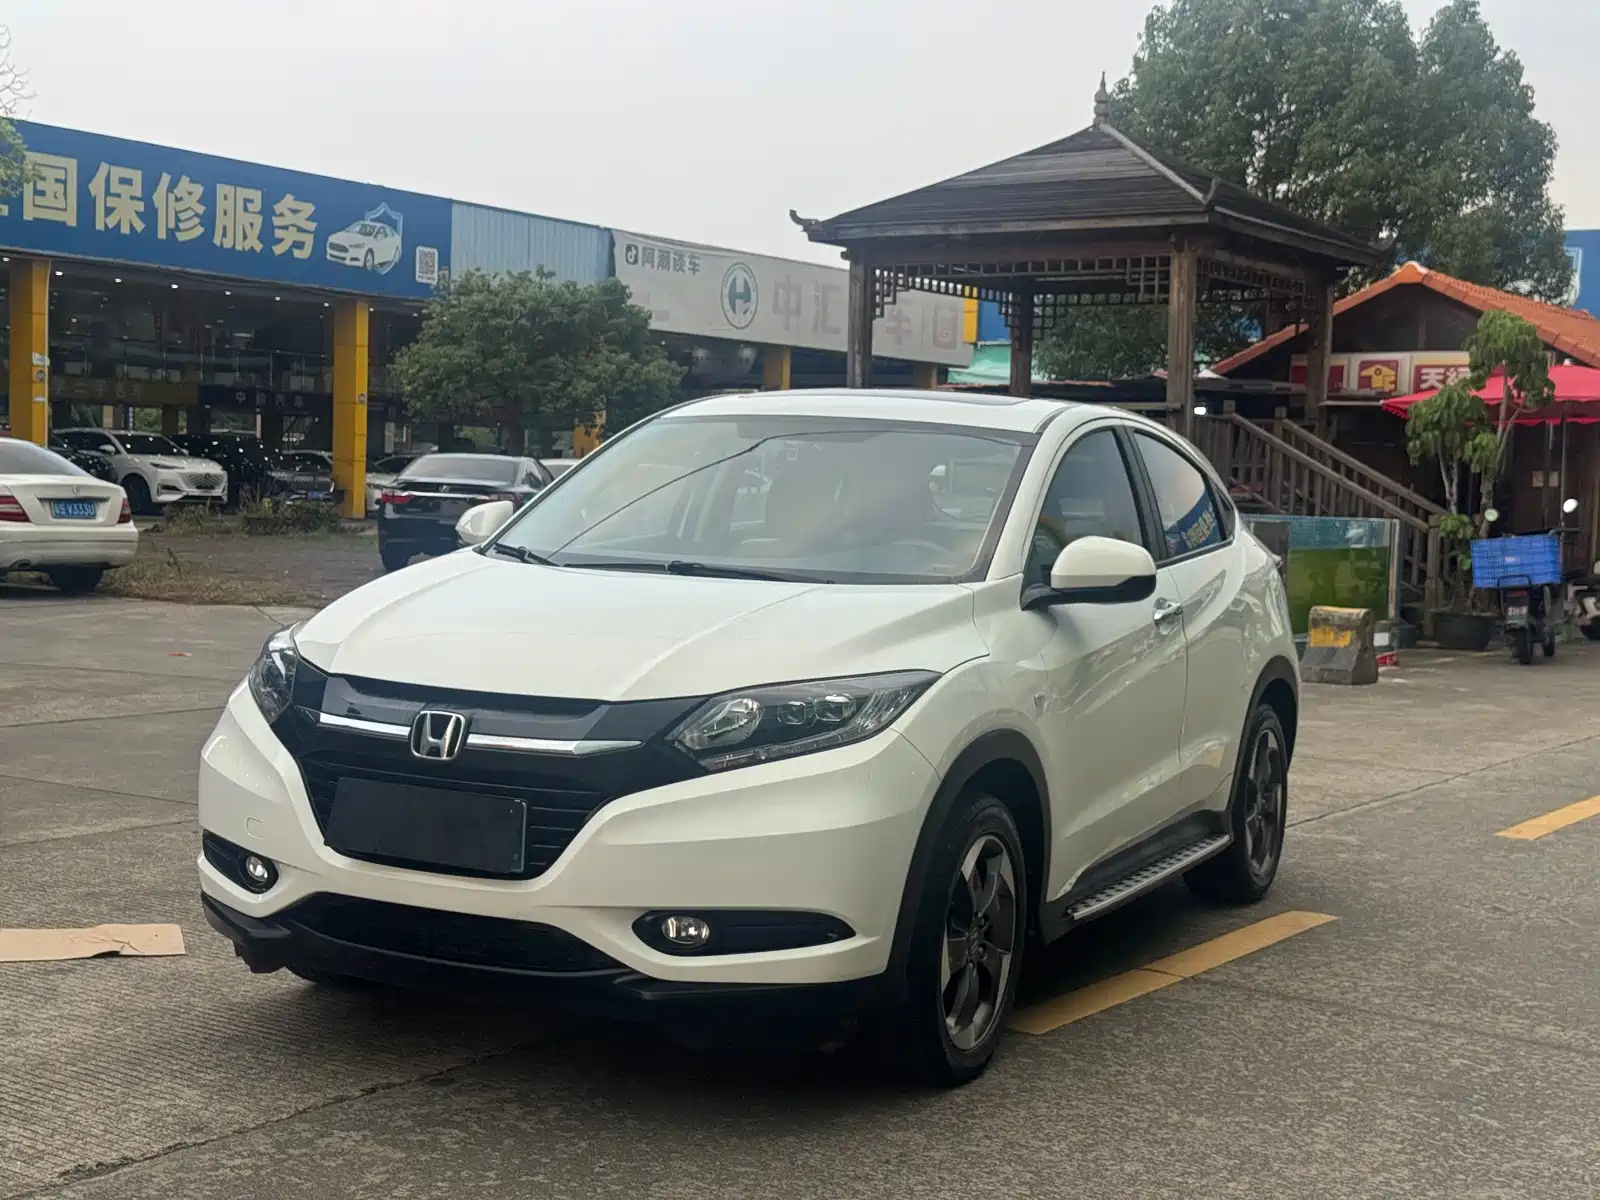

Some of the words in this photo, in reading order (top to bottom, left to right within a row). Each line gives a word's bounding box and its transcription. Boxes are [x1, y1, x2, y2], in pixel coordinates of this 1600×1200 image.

[0, 151, 319, 260] 国保修服务
